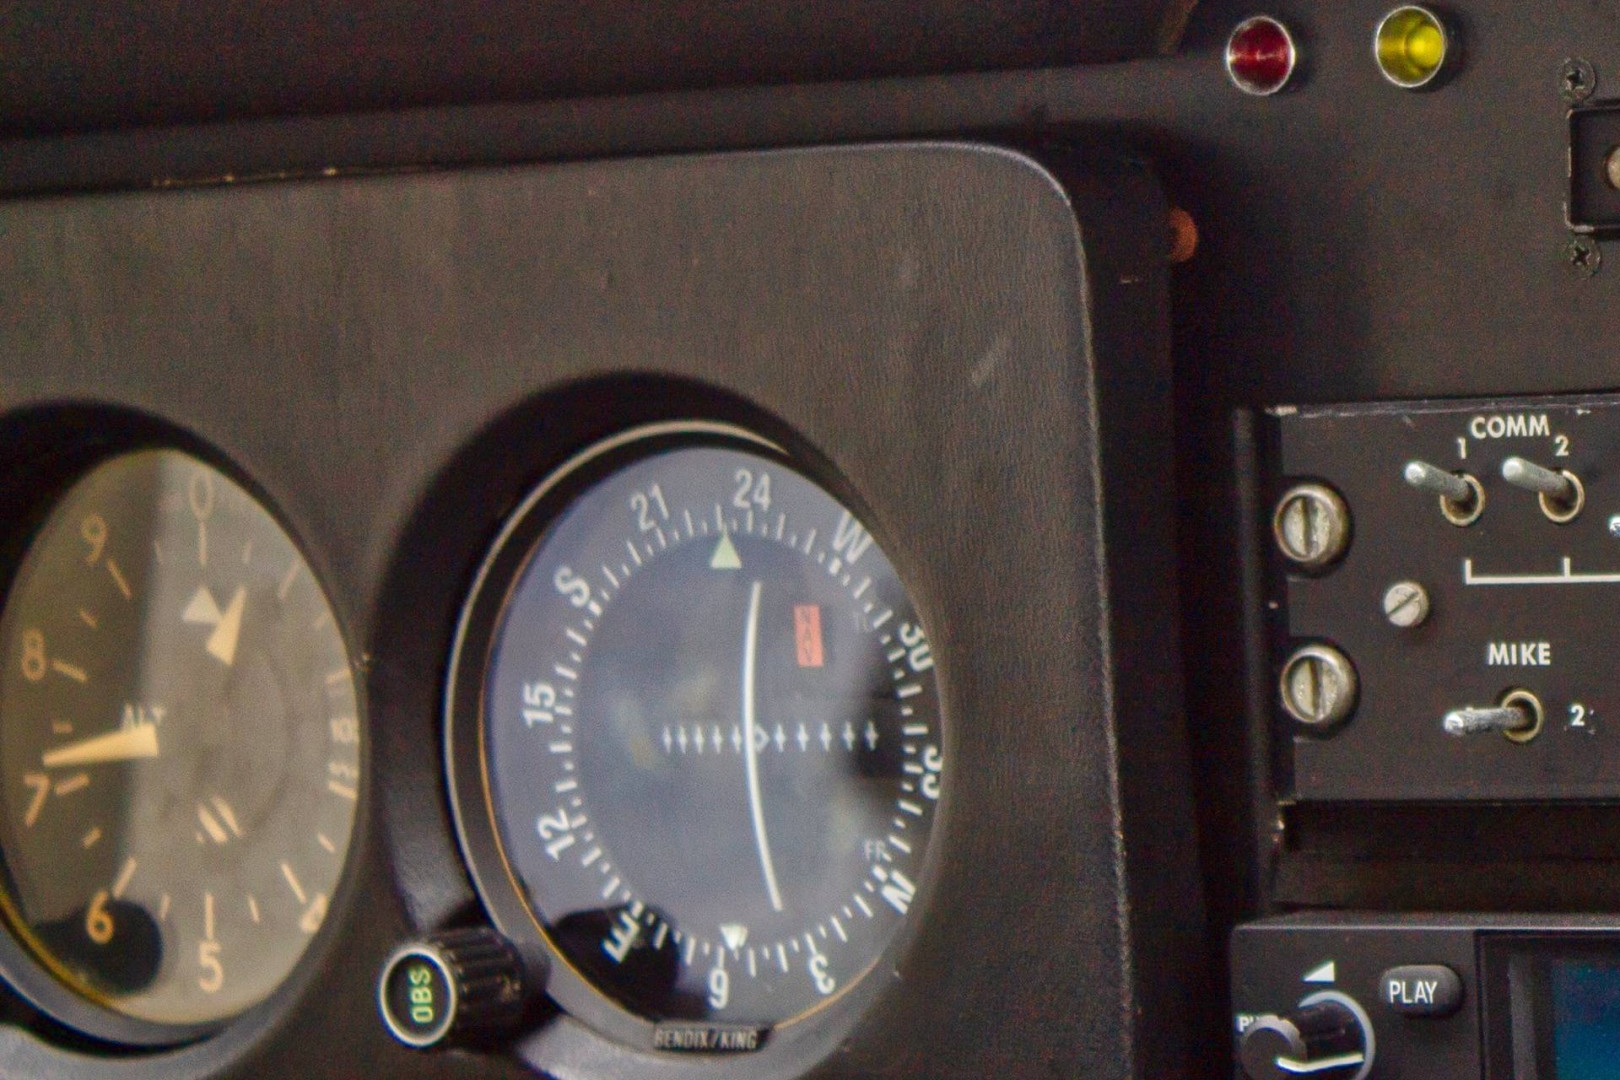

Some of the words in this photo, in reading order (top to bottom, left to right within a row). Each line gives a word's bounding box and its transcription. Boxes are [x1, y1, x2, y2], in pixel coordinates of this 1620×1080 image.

[1456, 437, 1467, 460] 1
[1470, 414, 1551, 440] COMM
[1555, 434, 1571, 457] 2
[189, 473, 215, 519] 0
[630, 482, 671, 531] 21
[733, 468, 773, 512] 24
[80, 516, 108, 565] 9
[832, 509, 874, 565] W
[553, 565, 592, 608] S
[21, 629, 46, 680] 8
[1486, 642, 1552, 667] MIKE
[521, 682, 558, 728] 15
[1570, 704, 1586, 728] 2
[23, 773, 53, 828] 7
[534, 812, 578, 861] 12
[880, 869, 918, 915] N
[85, 889, 115, 943] 6
[602, 913, 640, 962] E
[199, 940, 224, 993] 5
[708, 969, 729, 1010] 6
[808, 953, 837, 996] 3
[408, 966, 434, 1024] OBS
[1387, 980, 1439, 1007] PLAY
